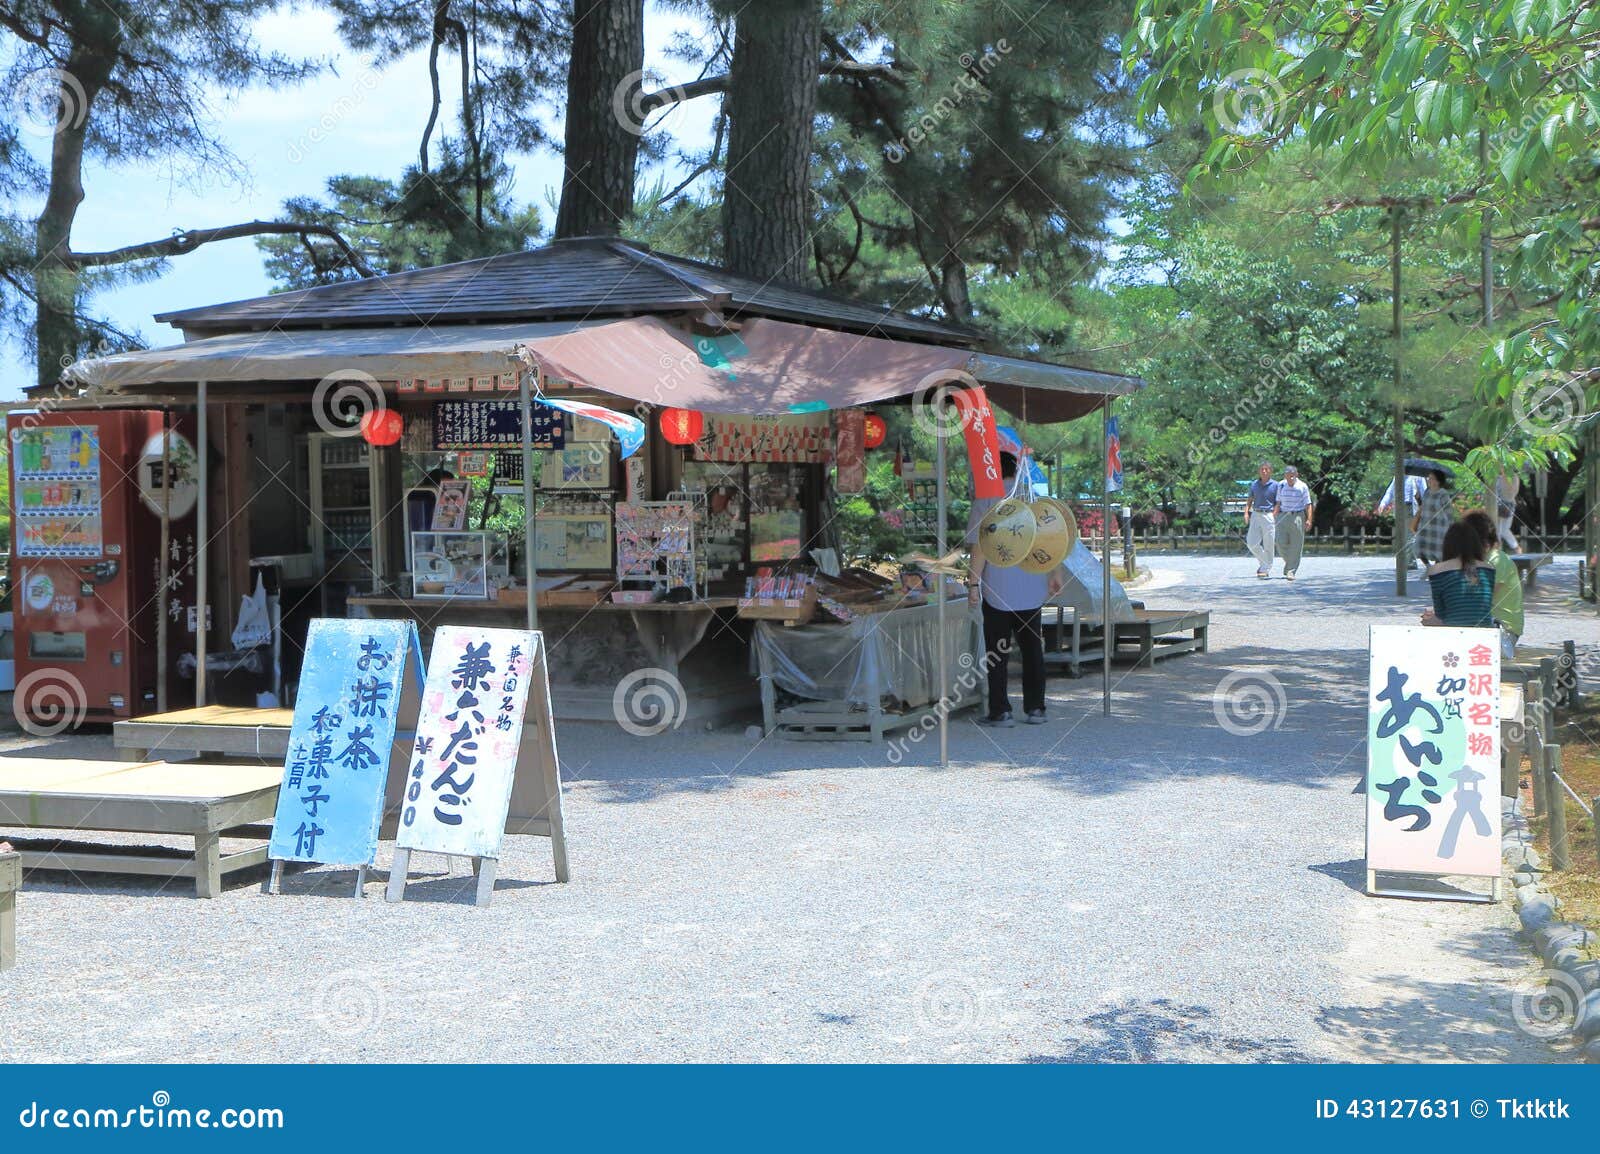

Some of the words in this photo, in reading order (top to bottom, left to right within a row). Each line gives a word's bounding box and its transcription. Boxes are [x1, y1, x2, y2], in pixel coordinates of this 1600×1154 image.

[335, 635, 393, 771] お抹茶
[431, 642, 495, 826] 兼六だんご
[495, 645, 523, 732] 兼六園名物
[1436, 674, 1467, 720] 加賀
[1467, 643, 1493, 757] 金沢名物
[288, 745, 308, 790] 七百円
[295, 704, 342, 858] 和菓子付
[403, 736, 434, 827] ¥400
